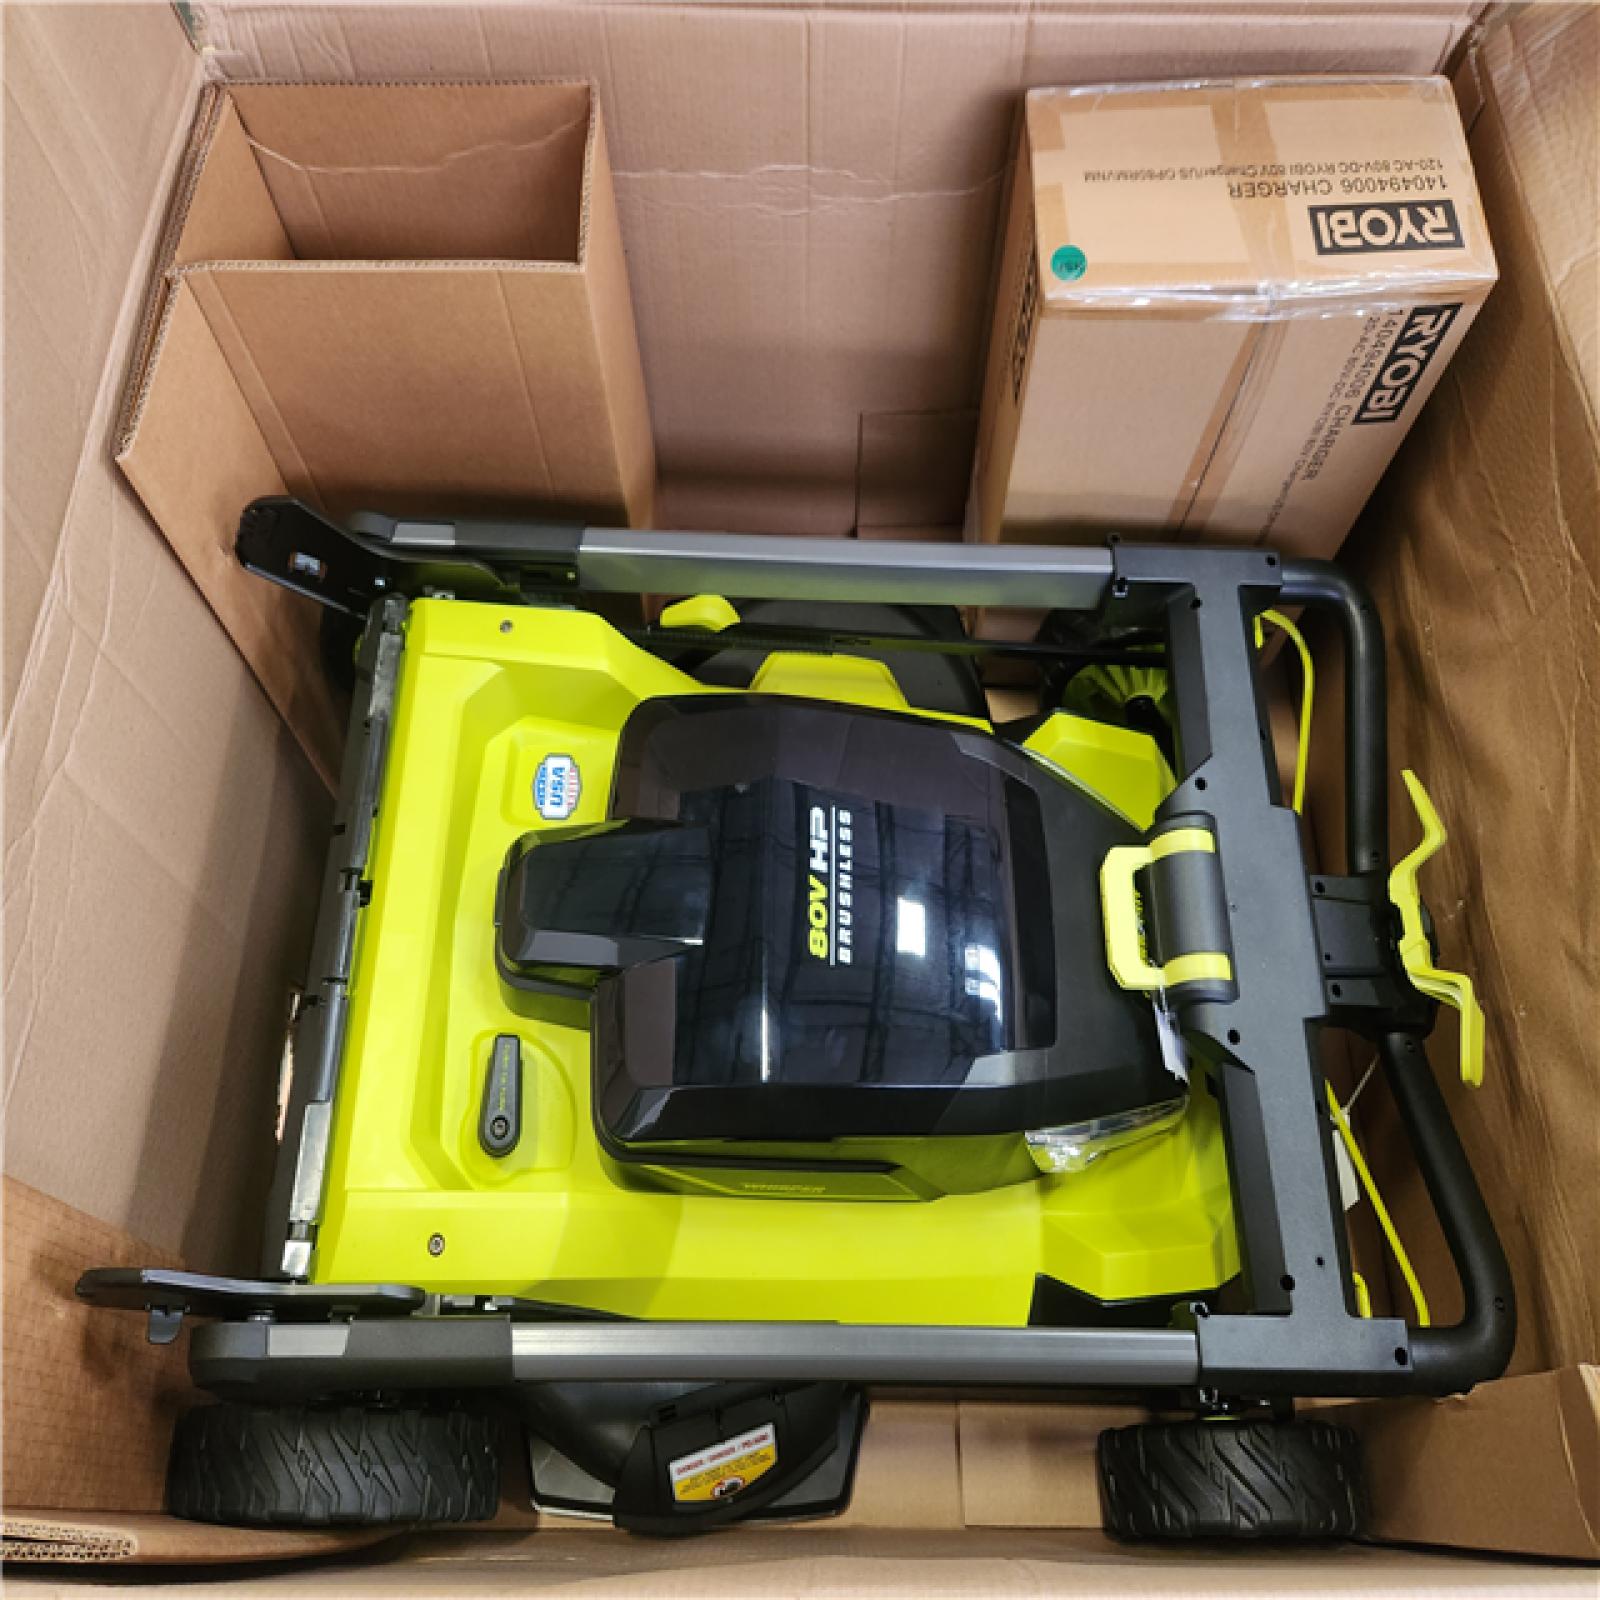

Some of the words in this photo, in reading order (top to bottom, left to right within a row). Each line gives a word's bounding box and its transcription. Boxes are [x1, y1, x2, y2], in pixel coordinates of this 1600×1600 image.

[1227, 178, 1334, 199] CHARGER
[1289, 162, 1336, 176] RYOBI
[1339, 174, 1448, 194] 140494006
[1315, 205, 1456, 249] RYOBI
[1359, 308, 1451, 420] RYOBI
[1301, 404, 1352, 481] CHARGER
[549, 767, 566, 807] USA
[809, 806, 829, 873] HP
[838, 809, 853, 965] BRUSHLESS
[808, 874, 829, 960] 80V
